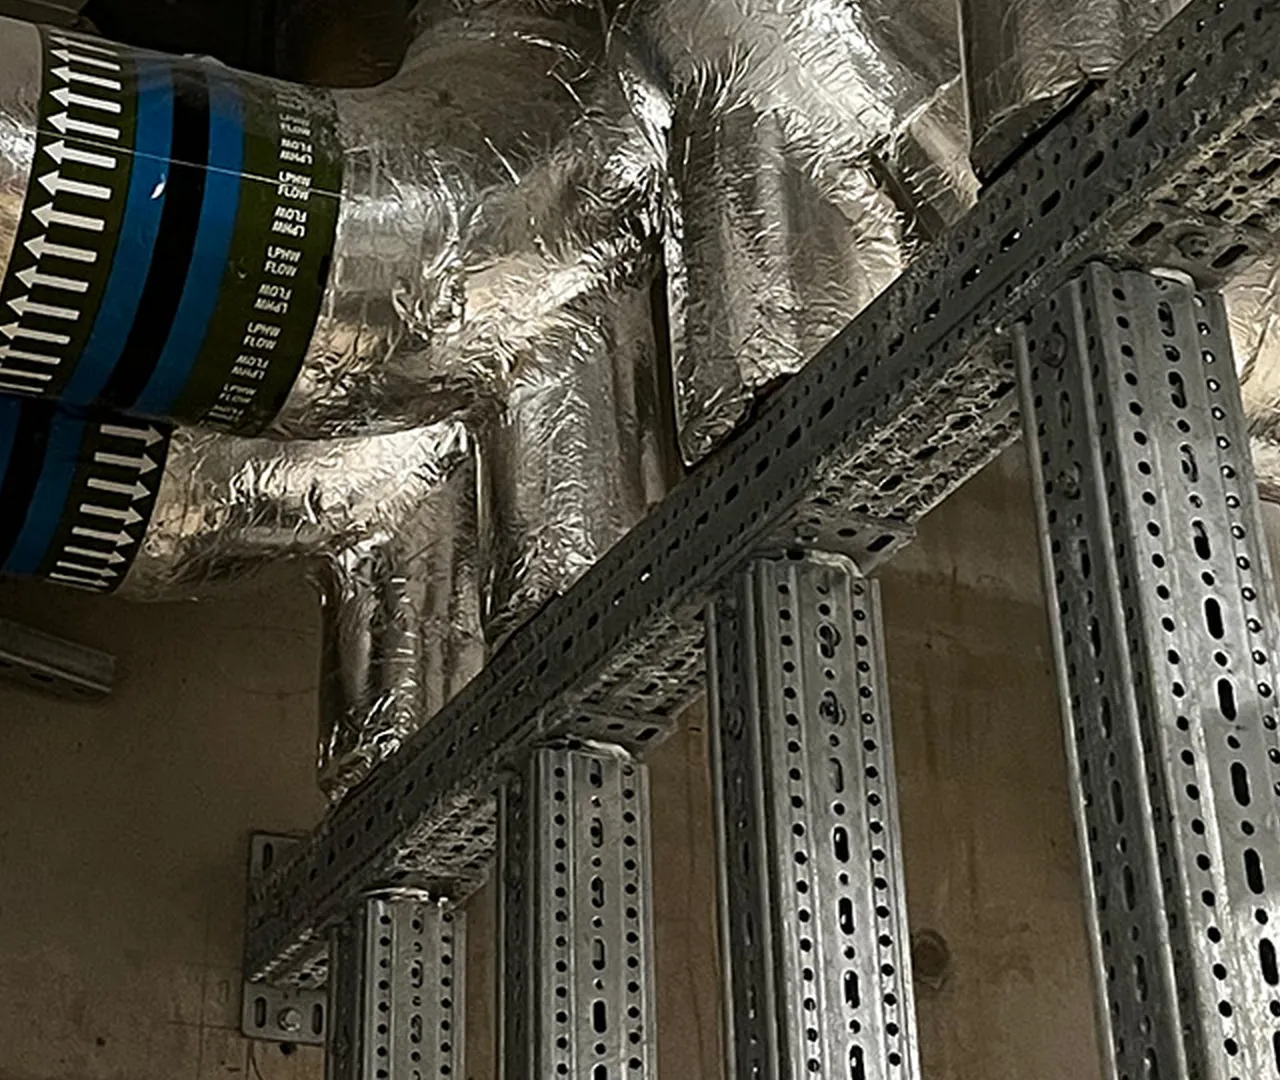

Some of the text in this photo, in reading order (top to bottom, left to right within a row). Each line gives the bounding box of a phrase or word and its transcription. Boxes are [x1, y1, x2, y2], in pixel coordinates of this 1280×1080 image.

[281, 138, 312, 153] FLOW
[279, 171, 311, 187] LPHW
[278, 183, 310, 201] FLOW
[274, 206, 307, 223] FLOW
[272, 220, 305, 237] LPHW
[267, 245, 301, 262] LPHW
[264, 260, 297, 277] FLOW
[258, 283, 292, 300] FLOW
[254, 297, 288, 314] LPHW
[247, 322, 281, 337] LPHW
[243, 335, 277, 350] FLOW
[236, 354, 269, 369] FLOW
[232, 365, 265, 380] LPHW
